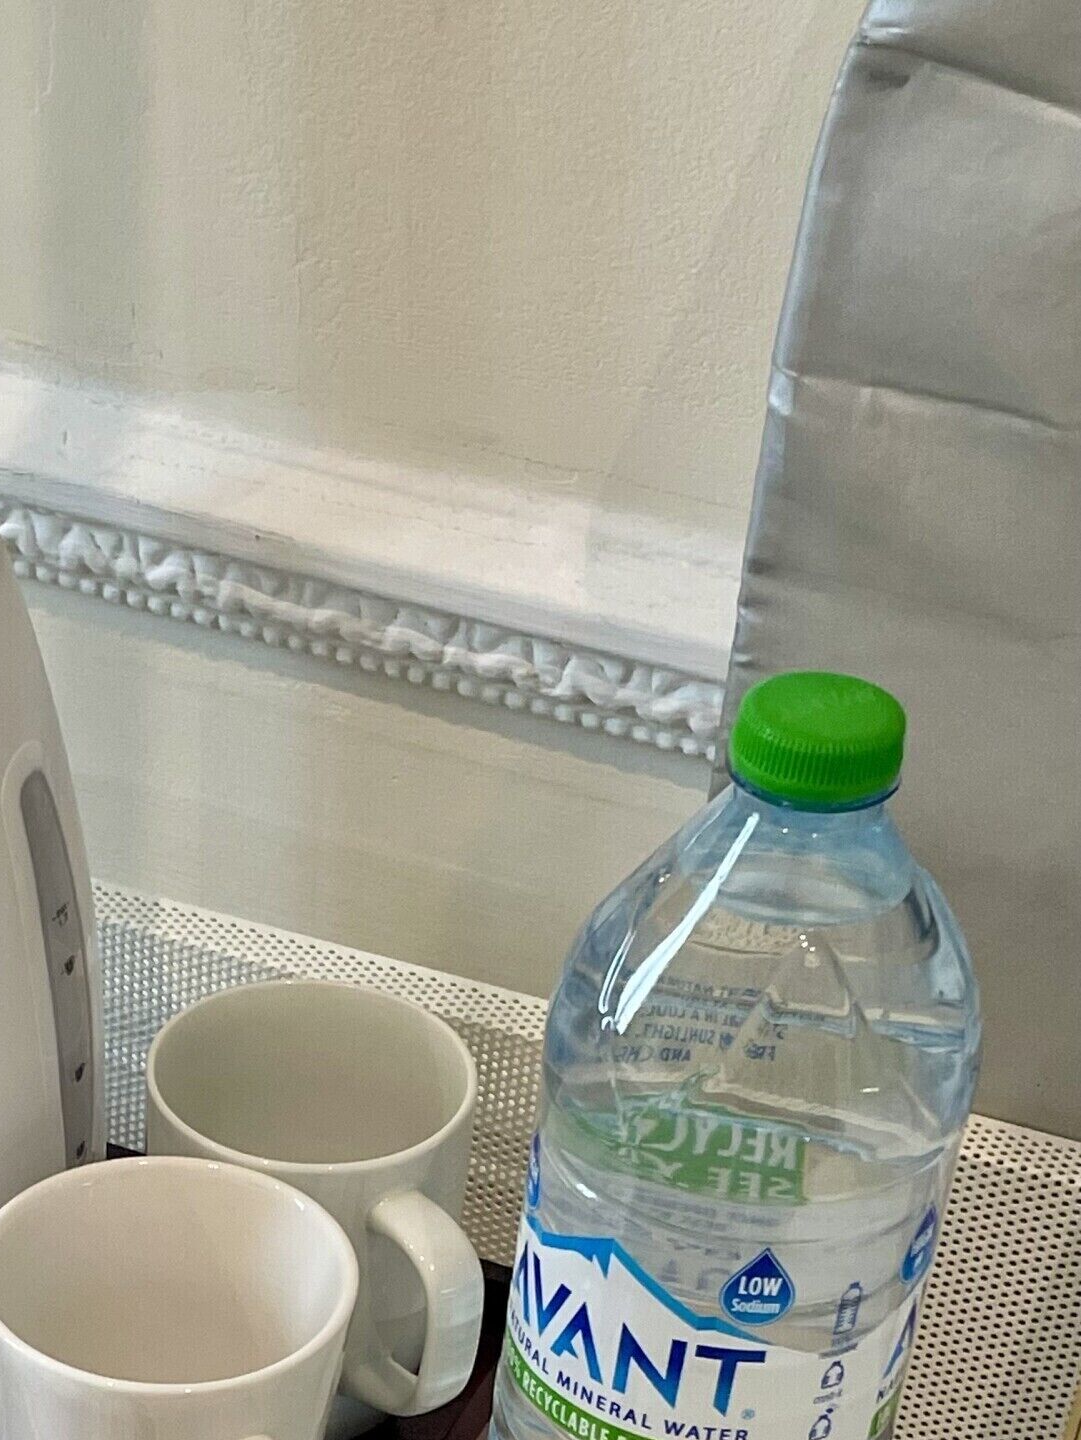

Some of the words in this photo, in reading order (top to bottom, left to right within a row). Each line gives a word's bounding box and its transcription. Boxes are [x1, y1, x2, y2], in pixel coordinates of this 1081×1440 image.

[738, 1275, 783, 1297] LOW
[730, 1298, 781, 1315] Sodium
[556, 1371, 652, 1430] MINERAL
